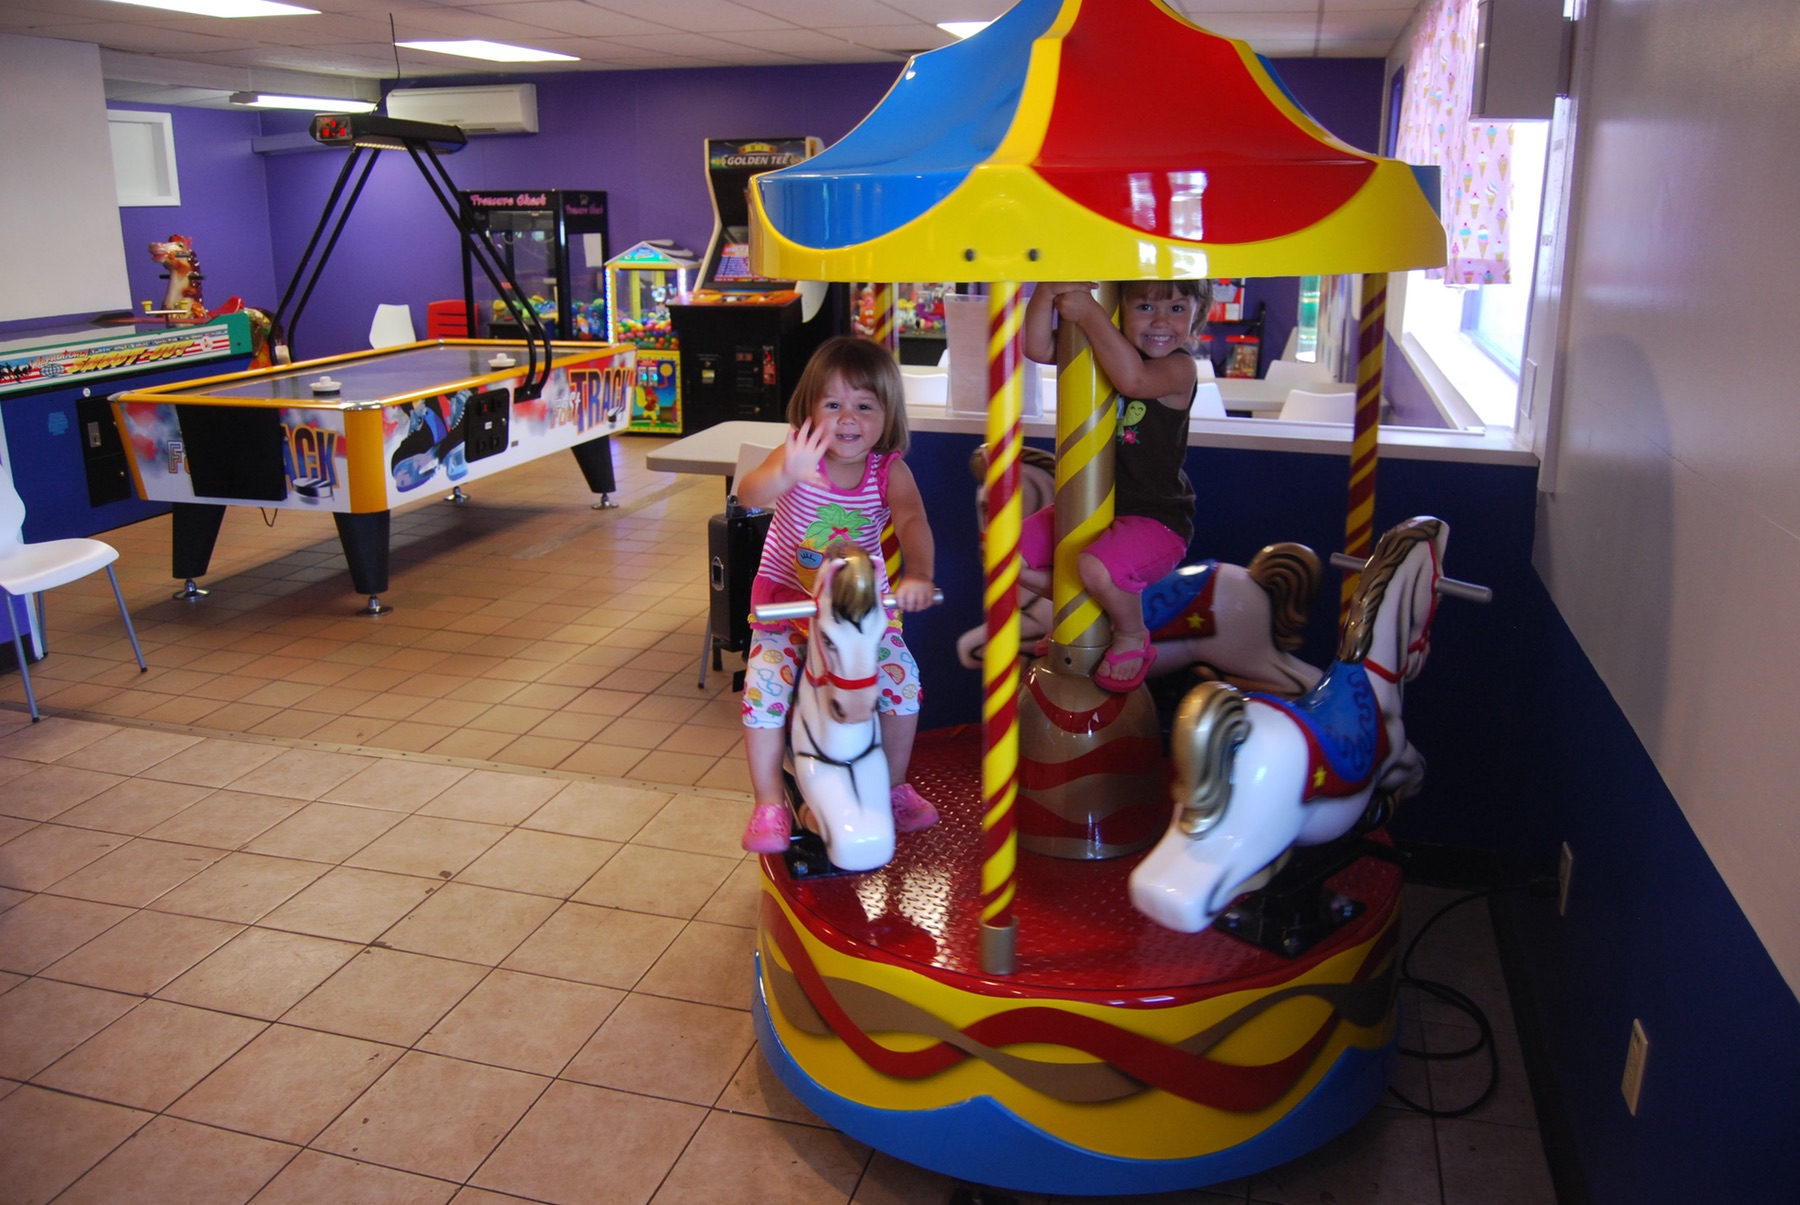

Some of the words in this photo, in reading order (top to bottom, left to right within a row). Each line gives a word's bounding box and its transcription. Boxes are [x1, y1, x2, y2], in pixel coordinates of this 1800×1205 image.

[727, 156, 768, 166] GOLDEN
[771, 156, 789, 165] TEE
[470, 194, 514, 206] Treasure
[516, 193, 547, 206] Chest
